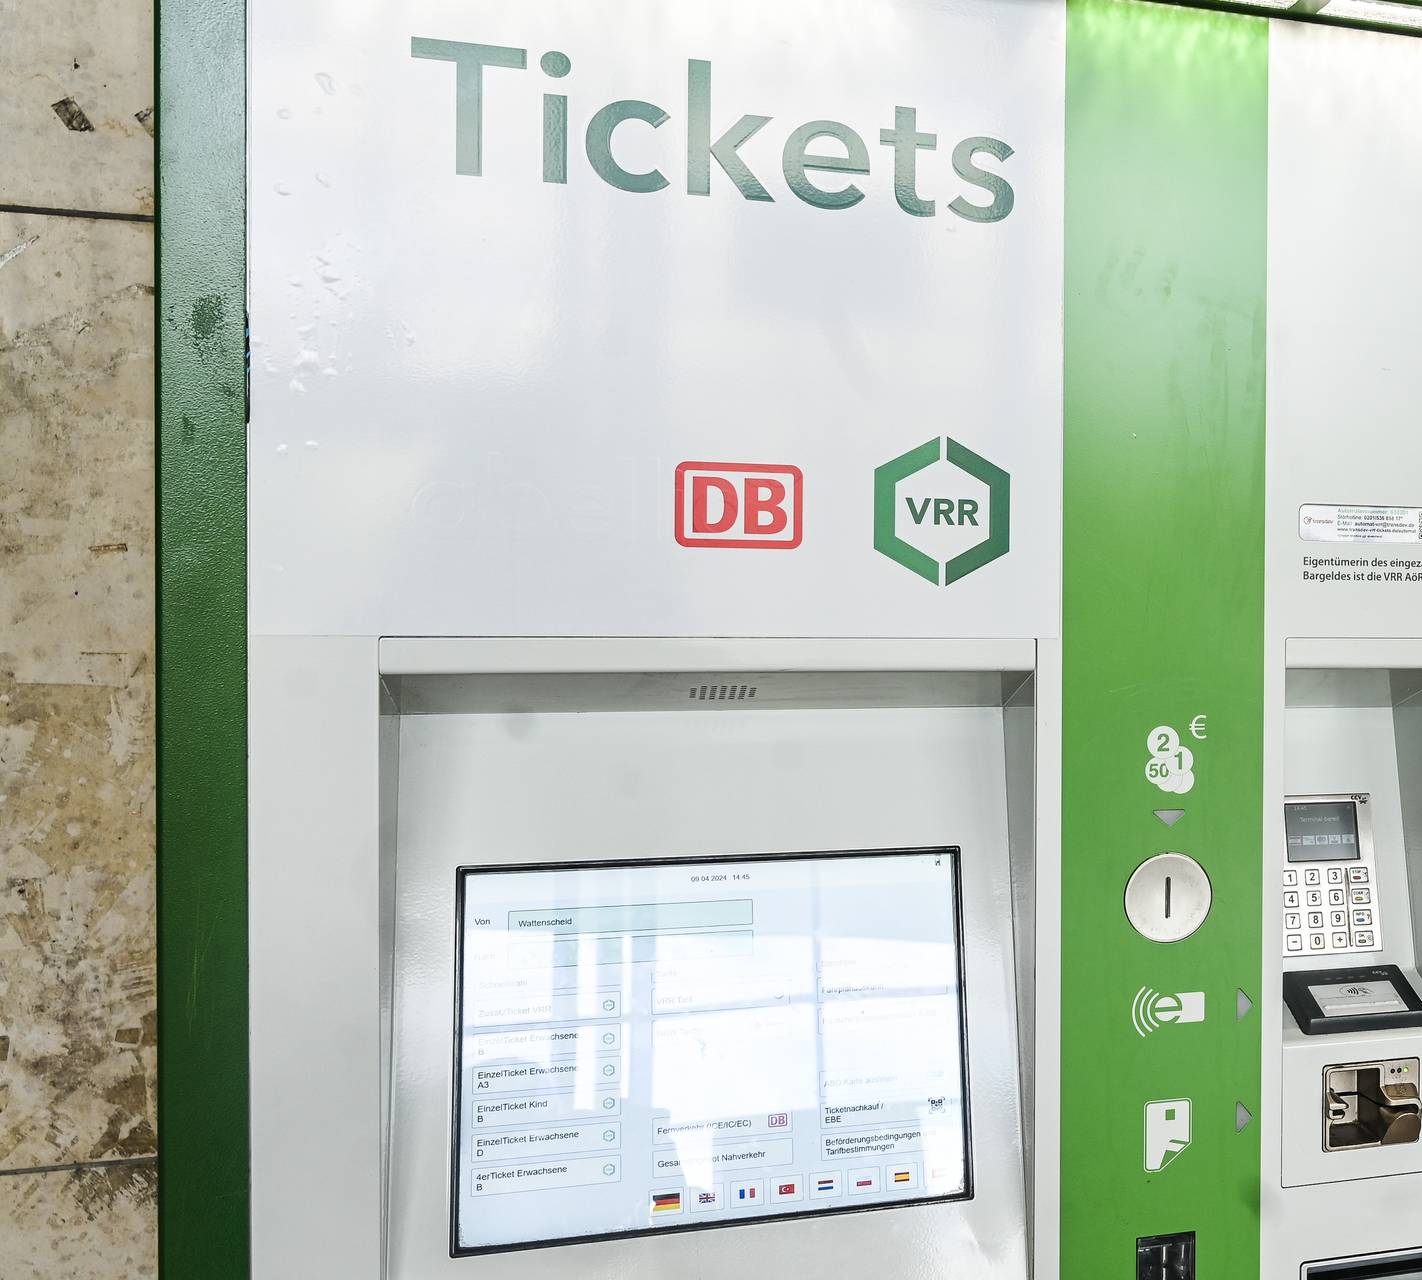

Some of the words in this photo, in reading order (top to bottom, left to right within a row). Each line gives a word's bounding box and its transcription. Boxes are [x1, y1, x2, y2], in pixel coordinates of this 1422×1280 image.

[410, 36, 1016, 224] Tickets
[691, 476, 788, 536] DB
[904, 495, 980, 527] VRR
[1303, 556, 1369, 568] Eigentümerin
[1371, 557, 1388, 567] des
[1303, 571, 1351, 582] Bargeldes
[1353, 571, 1364, 581] ist
[1366, 572, 1382, 581] die
[1384, 572, 1403, 581] VRR
[1156, 733, 1170, 752] 2
[1174, 751, 1183, 770] 1
[1148, 763, 1170, 778] 50
[1287, 873, 1292, 882] 1
[1309, 872, 1315, 881] 2
[1332, 871, 1338, 880] 3
[1288, 894, 1295, 903] 4
[1311, 893, 1317, 902] 5
[1333, 892, 1340, 901] 6
[474, 917, 491, 927] Von
[518, 917, 573, 928] Wattenscheid
[1290, 915, 1296, 925] 7
[1313, 915, 1319, 924] 8
[1335, 913, 1341, 923] 9
[1314, 936, 1320, 945] 0
[477, 1068, 528, 1080] EinzelTicket
[529, 1064, 579, 1076] Erwachsene
[477, 1081, 490, 1089] A3
[477, 1101, 528, 1113] EinzelTicket
[529, 1100, 548, 1109] Kind
[824, 1103, 880, 1114] Ticketnachkauf
[477, 1115, 484, 1123] B
[770, 1115, 786, 1126] DB
[824, 1115, 842, 1124] EBE
[476, 1135, 528, 1147] EinzelTicket
[529, 1131, 580, 1143] Erwachsene
[825, 1131, 922, 1147] Beförderungsbedingungen
[476, 1149, 484, 1157] D
[825, 1143, 895, 1156] Tarifbestimmungen
[721, 1151, 766, 1162] Nahverkehr
[476, 1170, 516, 1181] 4erTicket
[517, 1166, 568, 1178] Erwachsene
